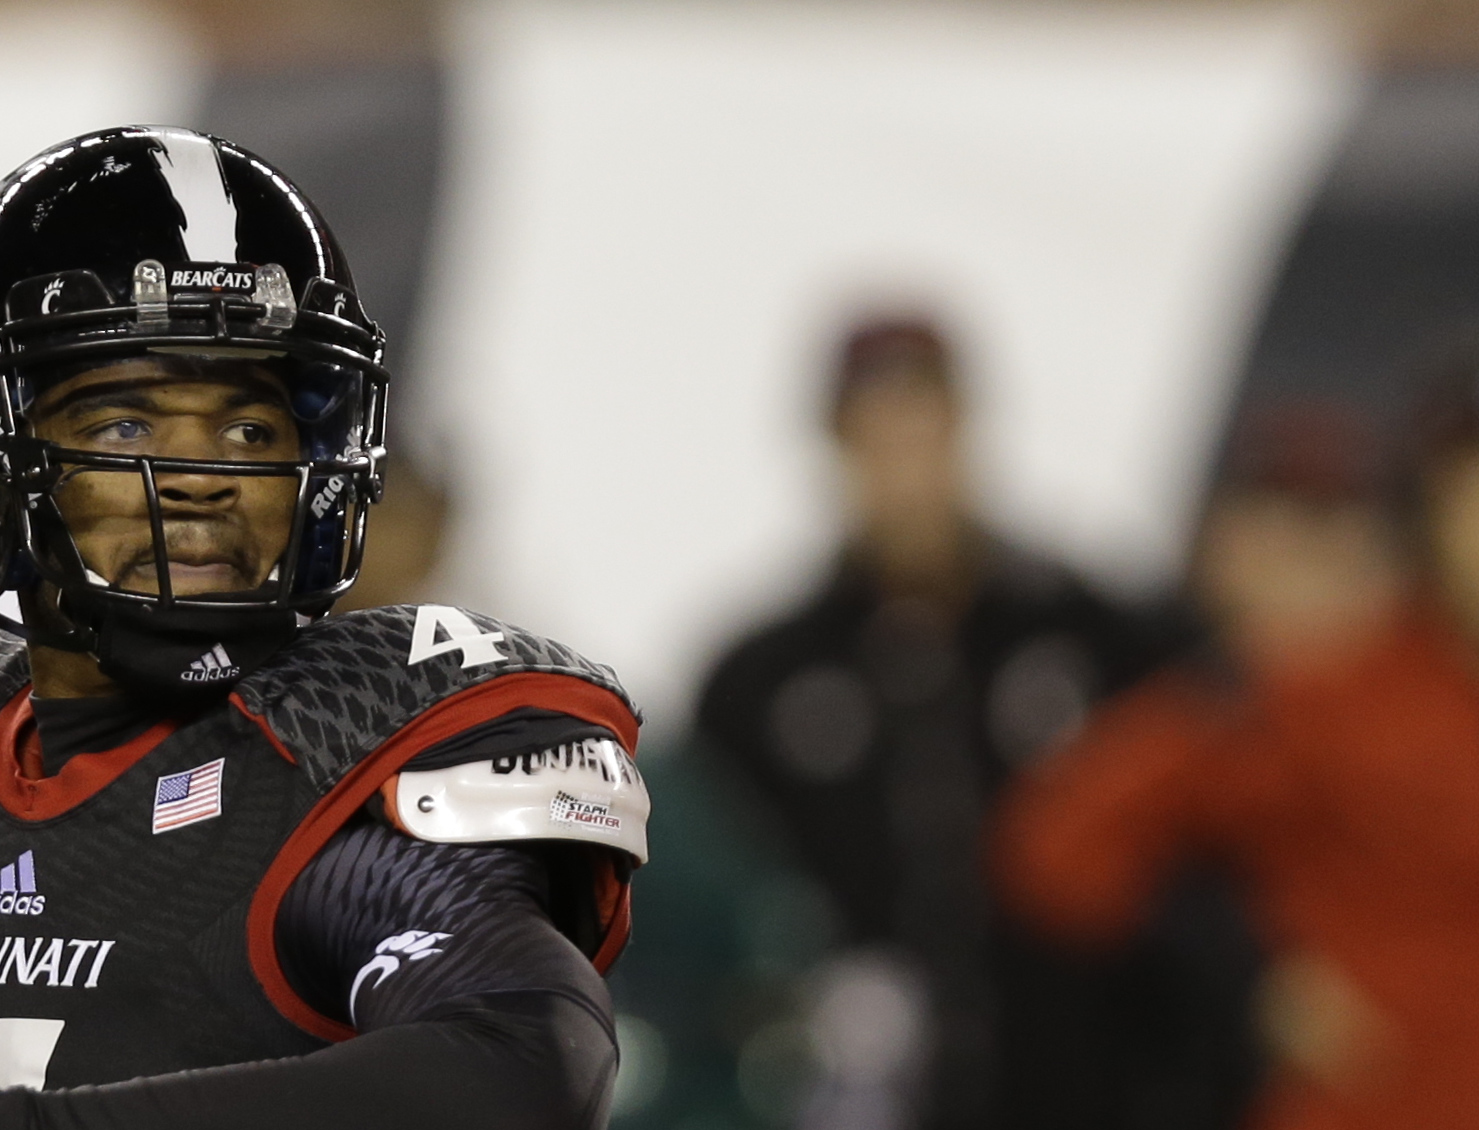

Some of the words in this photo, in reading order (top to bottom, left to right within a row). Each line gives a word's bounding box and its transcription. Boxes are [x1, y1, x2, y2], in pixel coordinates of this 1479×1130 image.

[170, 268, 252, 289] BEARCATS
[406, 605, 509, 669] 4
[567, 802, 608, 816] STAPH
[564, 810, 620, 829] FIGHTER
